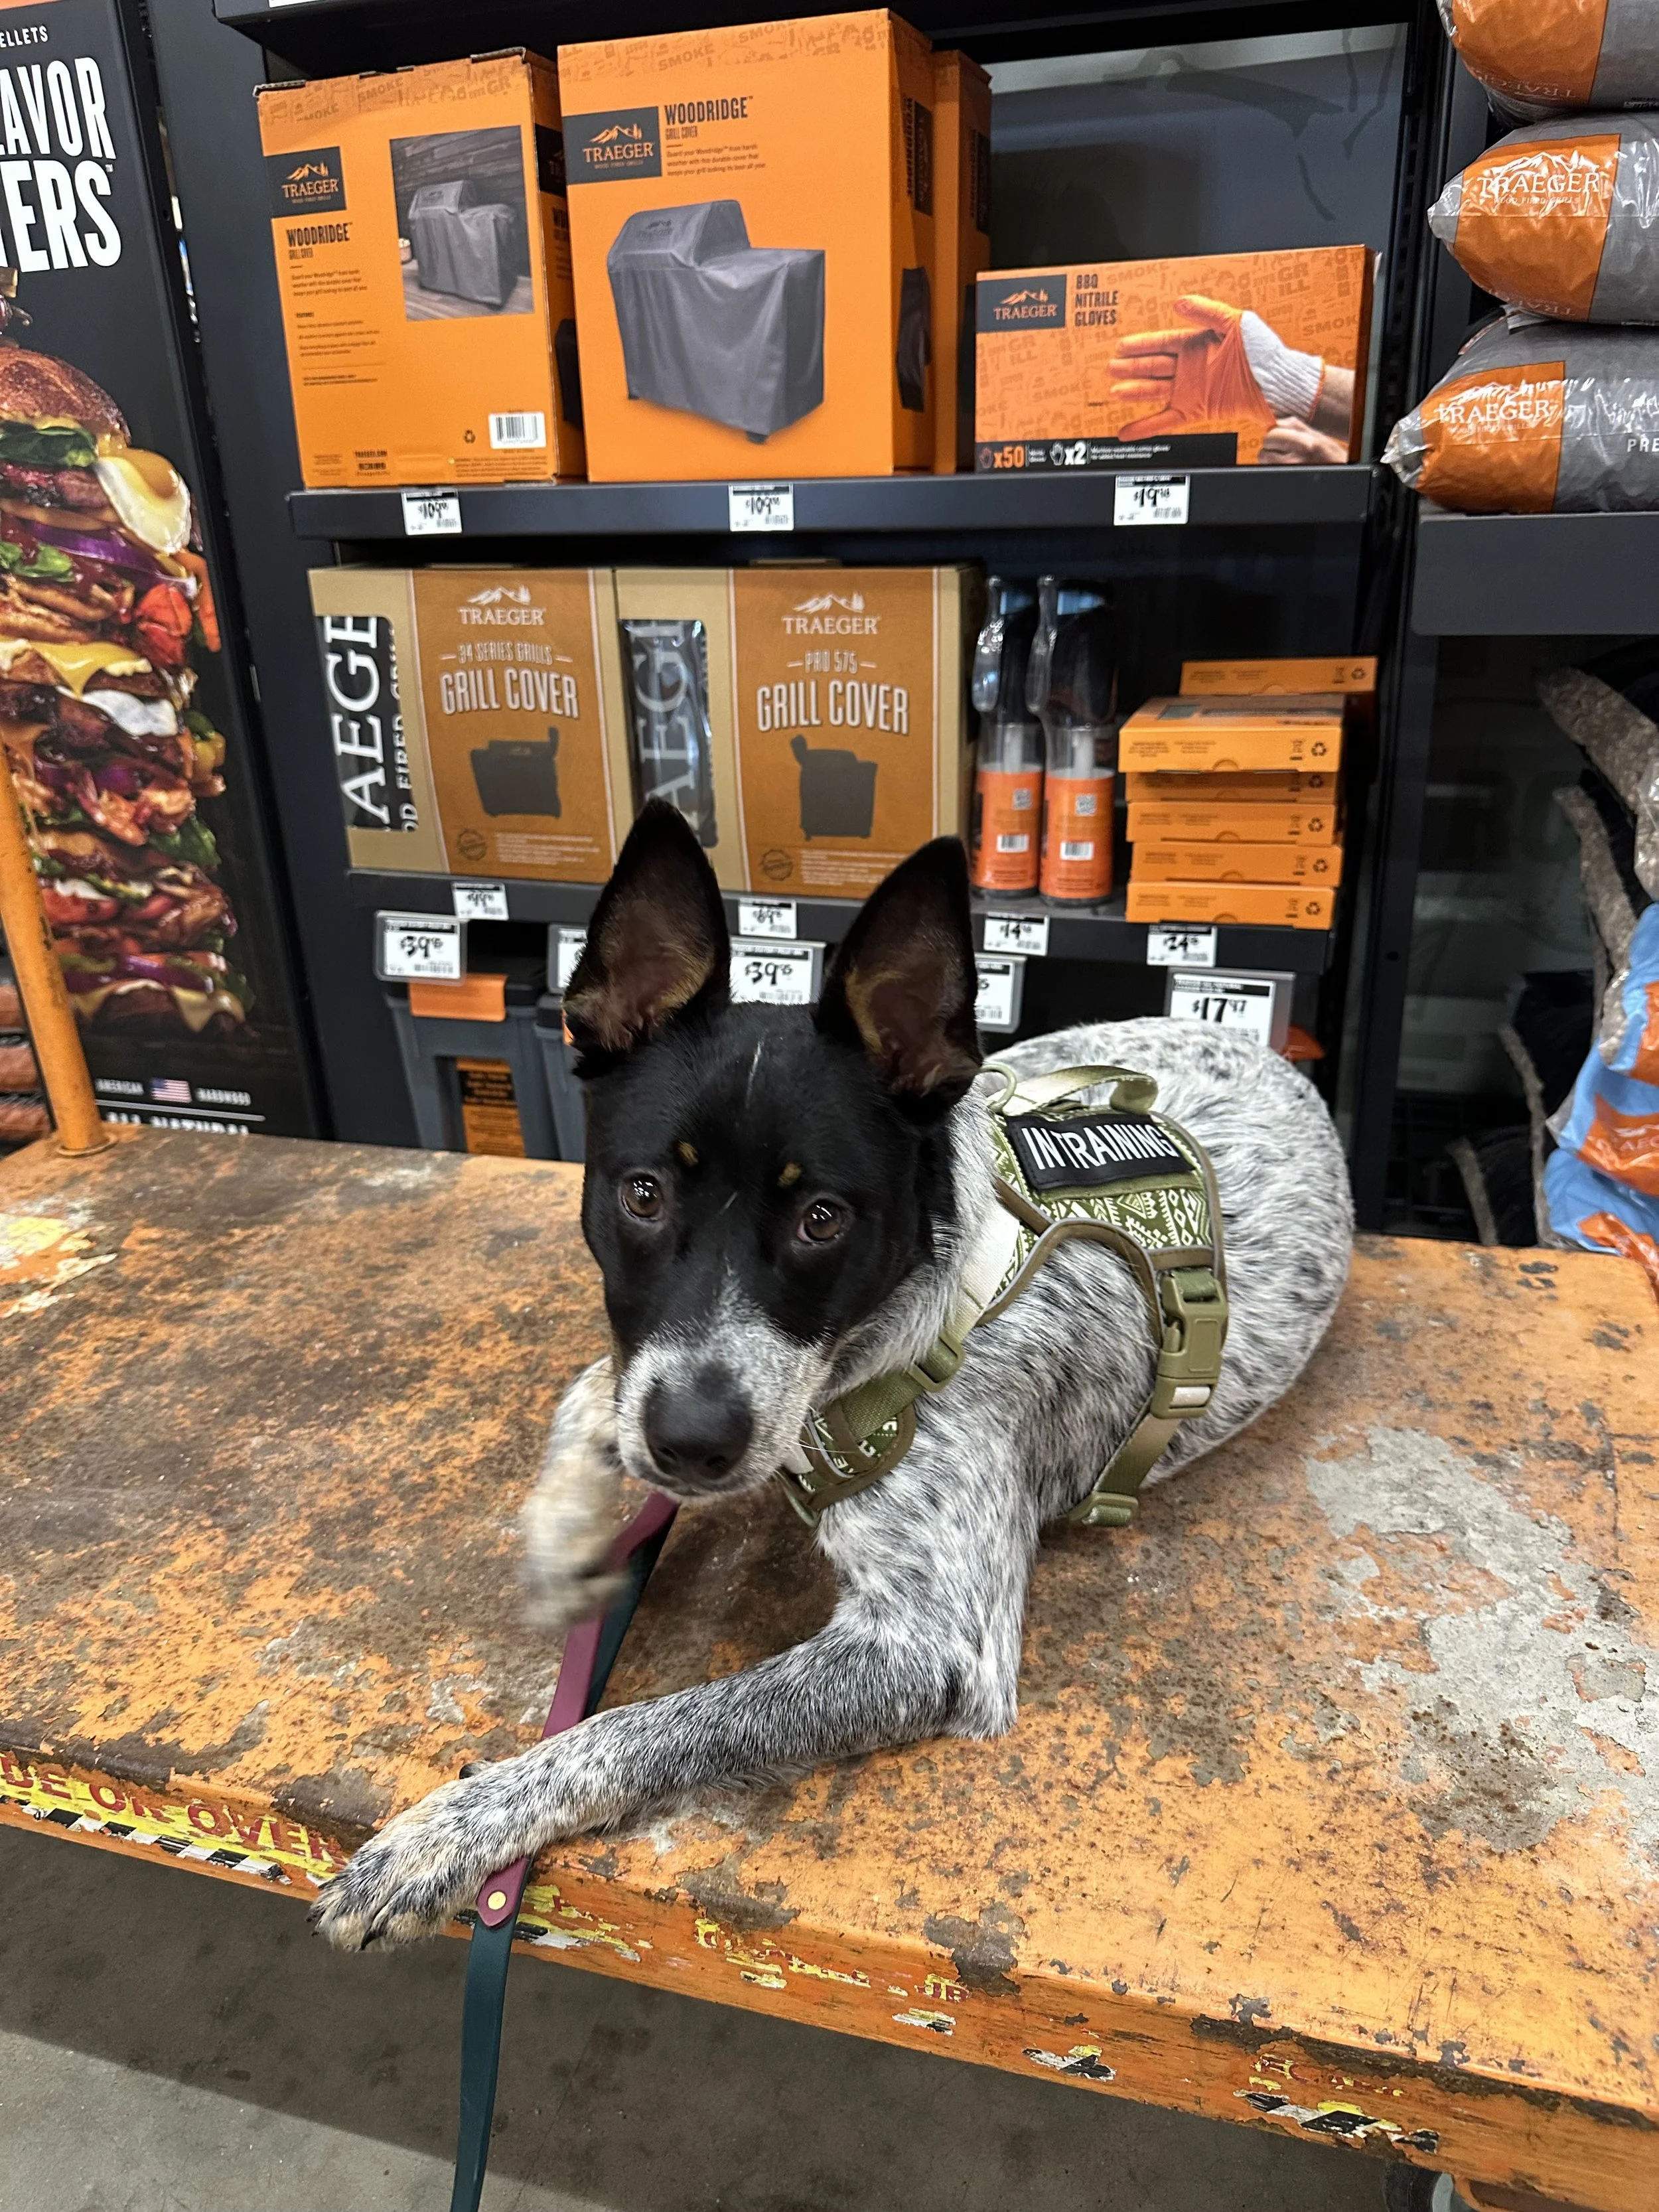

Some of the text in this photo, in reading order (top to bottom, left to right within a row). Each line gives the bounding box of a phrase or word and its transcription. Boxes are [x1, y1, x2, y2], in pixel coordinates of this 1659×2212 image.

[658, 43, 715, 72] SMOKE
[0, 57, 116, 159] AVOR
[582, 142, 654, 163] TRAEGER
[281, 179, 340, 198] TRAEGER
[1477, 172, 1599, 198] TRAEGER
[0, 160, 121, 273] ERS
[1076, 273, 1099, 289] BBQ
[993, 304, 1058, 320] TRAEGER
[1075, 291, 1118, 308] NITRILE
[1074, 309, 1117, 327] GLOVES
[1435, 399, 1550, 424] TRAEGER
[993, 445, 1024, 468] x50
[1064, 440, 1087, 465] x2
[458, 607, 545, 626] TRAEGER
[782, 615, 880, 635] TRAEGER
[458, 641, 553, 666] 34 SERIES GRILLS
[805, 648, 859, 674] PRO 575
[441, 666, 579, 718] GRILL COVER
[757, 678, 908, 735] GRILL COVER
[1021, 1123, 1180, 1170] IN TRAINING
